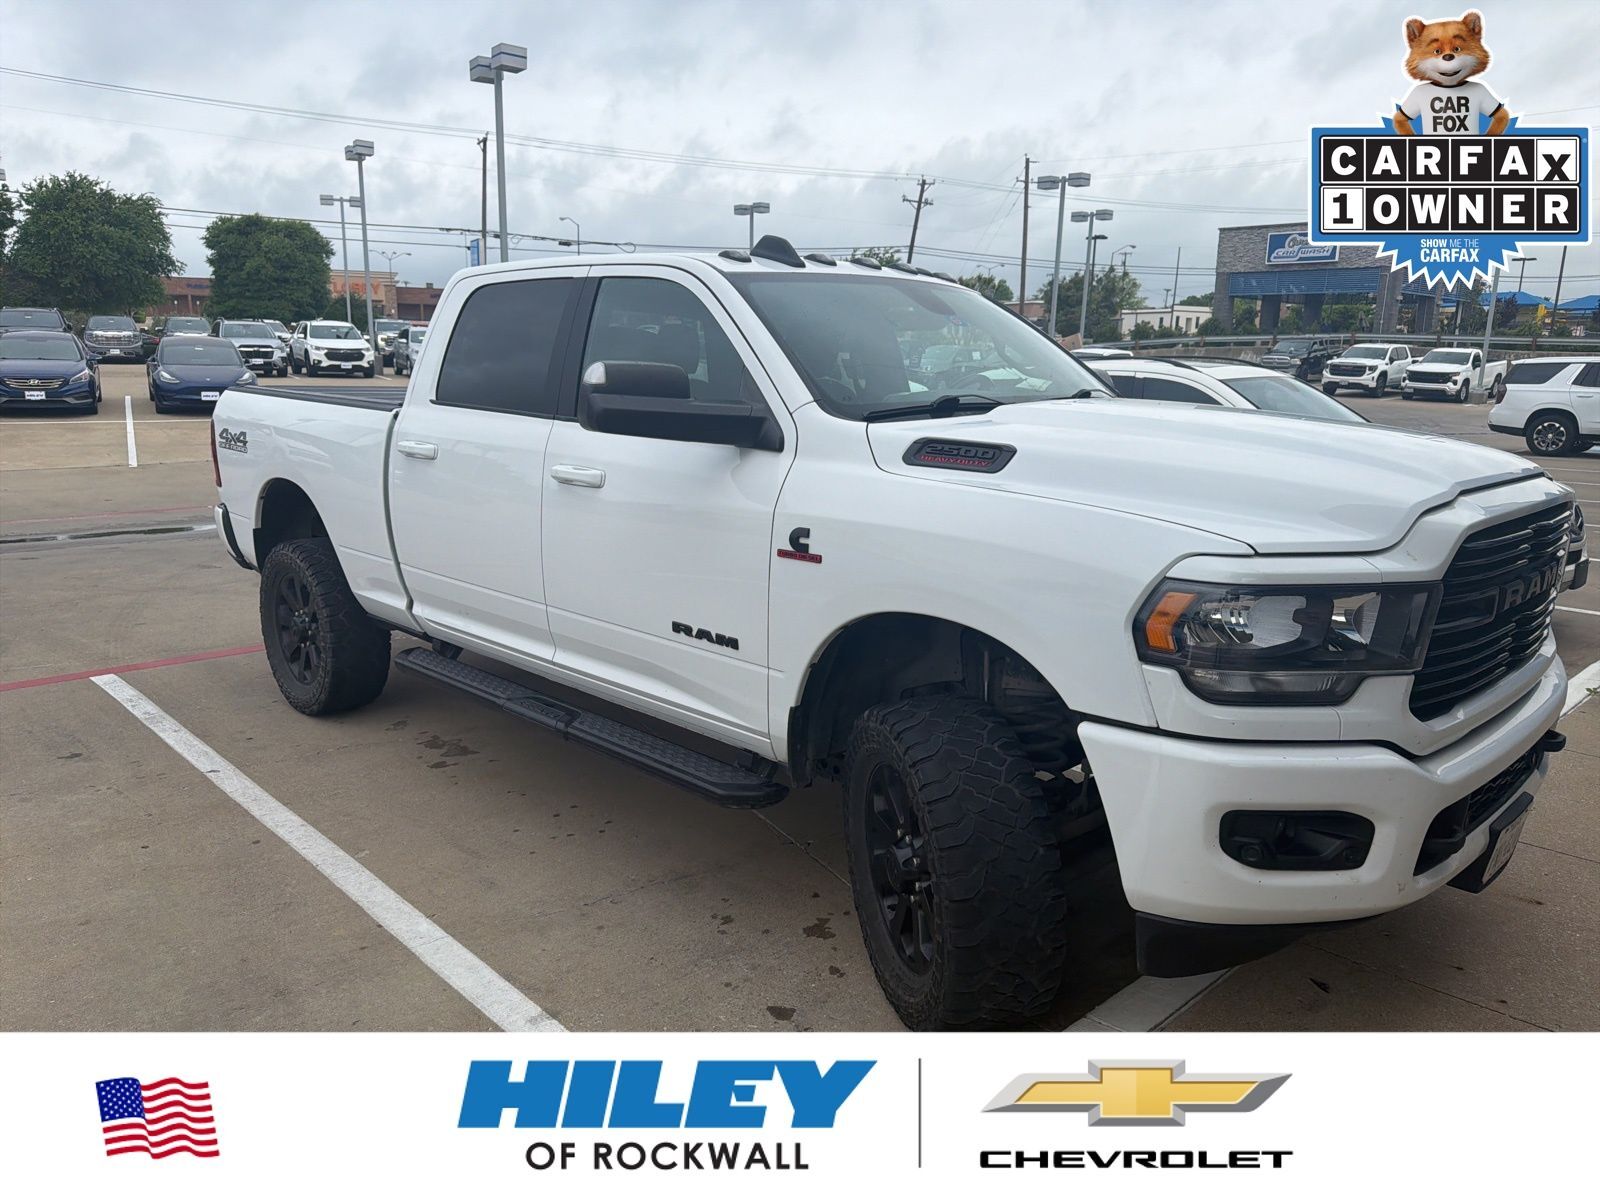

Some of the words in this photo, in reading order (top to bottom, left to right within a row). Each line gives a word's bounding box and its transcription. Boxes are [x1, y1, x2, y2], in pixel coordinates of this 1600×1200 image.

[1275, 249, 1297, 257] CAR
[1300, 247, 1330, 256] WASH
[925, 444, 996, 460] 2500
[1503, 562, 1558, 611] RAM
[671, 620, 740, 651] RAM
